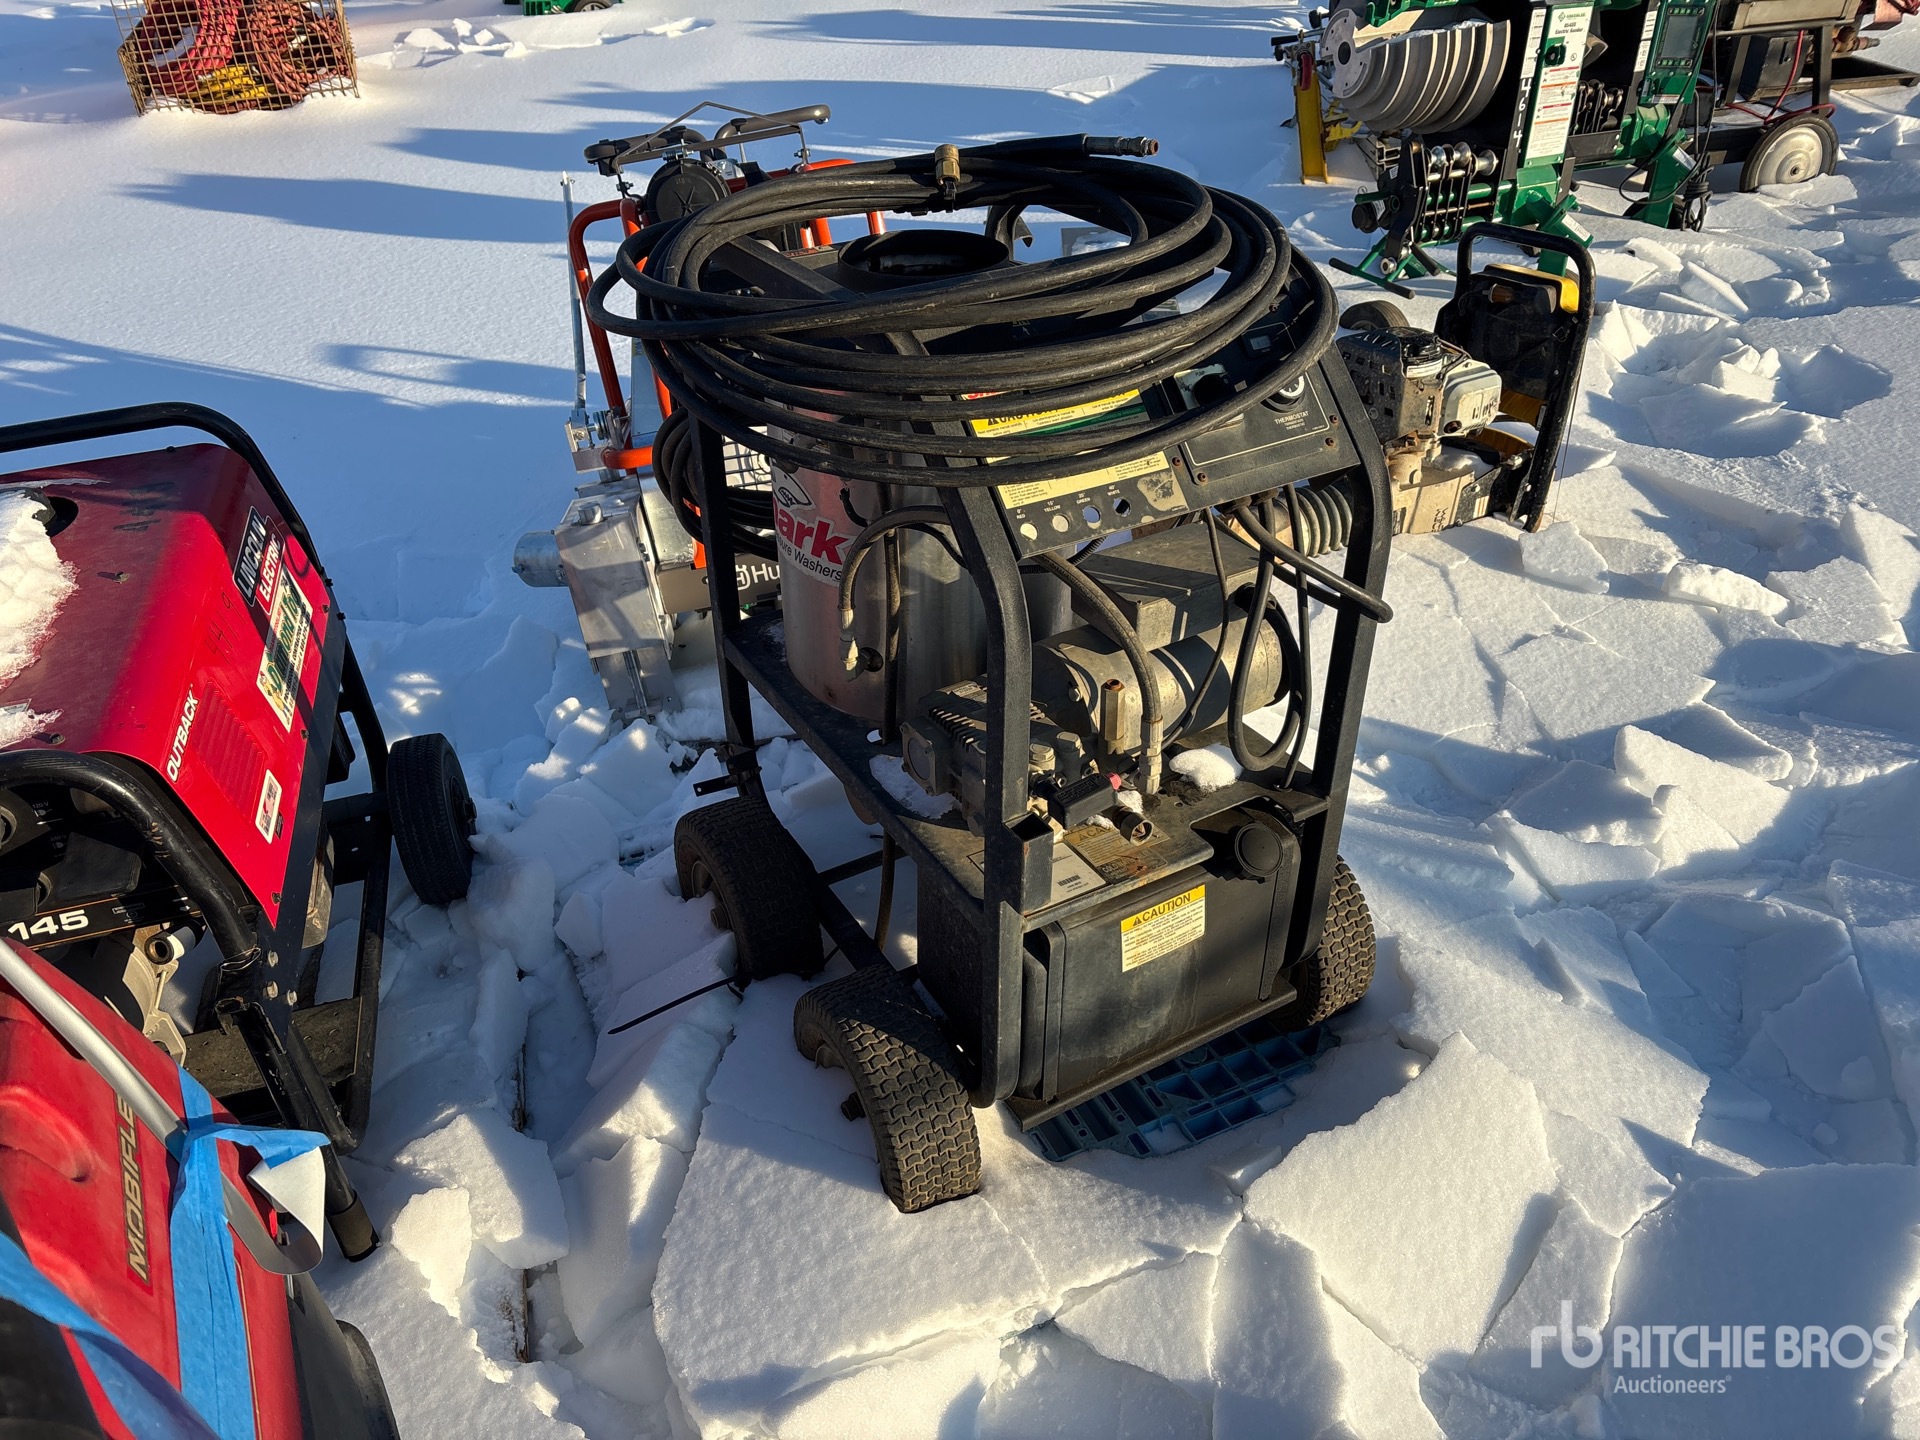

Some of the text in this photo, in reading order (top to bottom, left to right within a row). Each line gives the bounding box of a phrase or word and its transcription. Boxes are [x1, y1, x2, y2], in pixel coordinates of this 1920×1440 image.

[1513, 78, 1532, 148] 4614
[1274, 410, 1309, 425] THERMOSTAT
[1043, 504, 1061, 513] YELLOW
[1076, 497, 1091, 505] GREEN
[237, 514, 267, 599] LINCOLN
[259, 533, 281, 603] ELECTRIC
[795, 548, 842, 581] Washers
[167, 690, 199, 782] OUTBACK
[1142, 893, 1191, 922] CAUTION
[8, 909, 89, 941] 145
